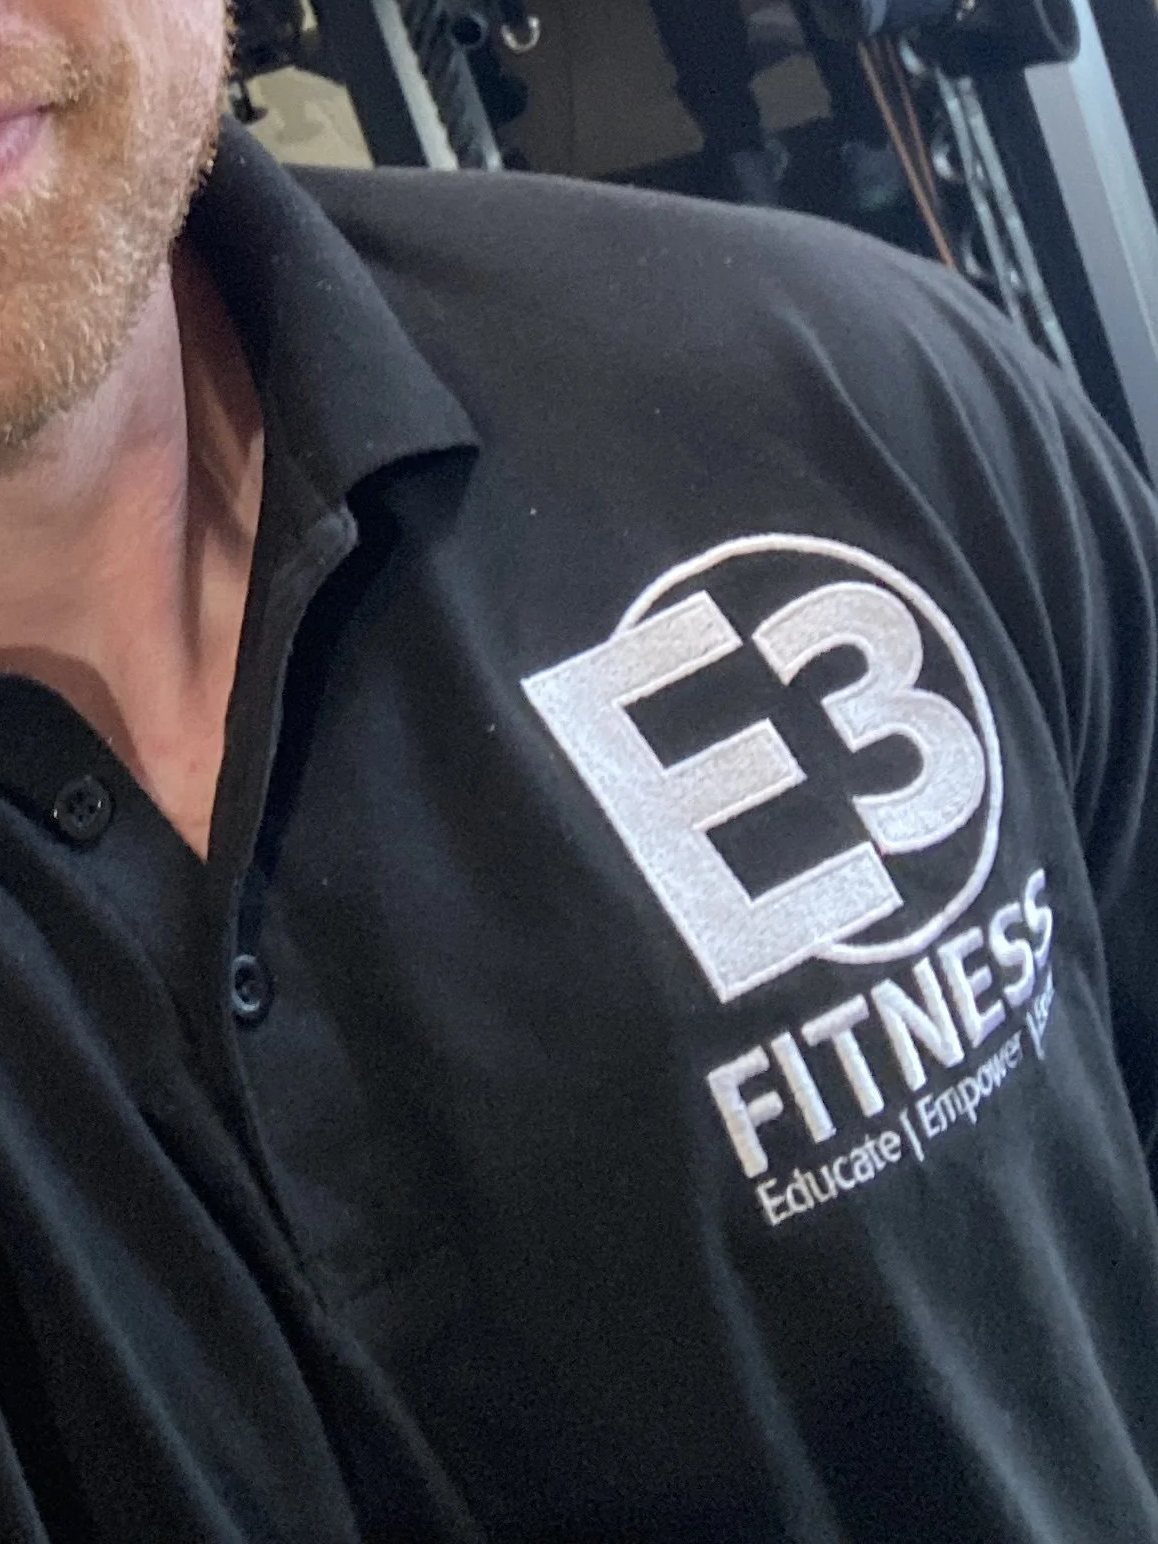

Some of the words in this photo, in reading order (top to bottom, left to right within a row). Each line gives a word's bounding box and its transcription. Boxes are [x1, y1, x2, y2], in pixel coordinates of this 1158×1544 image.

[520, 580, 987, 1004] E3
[707, 867, 1053, 1179] FITNESS
[756, 1131, 903, 1228] Educate
